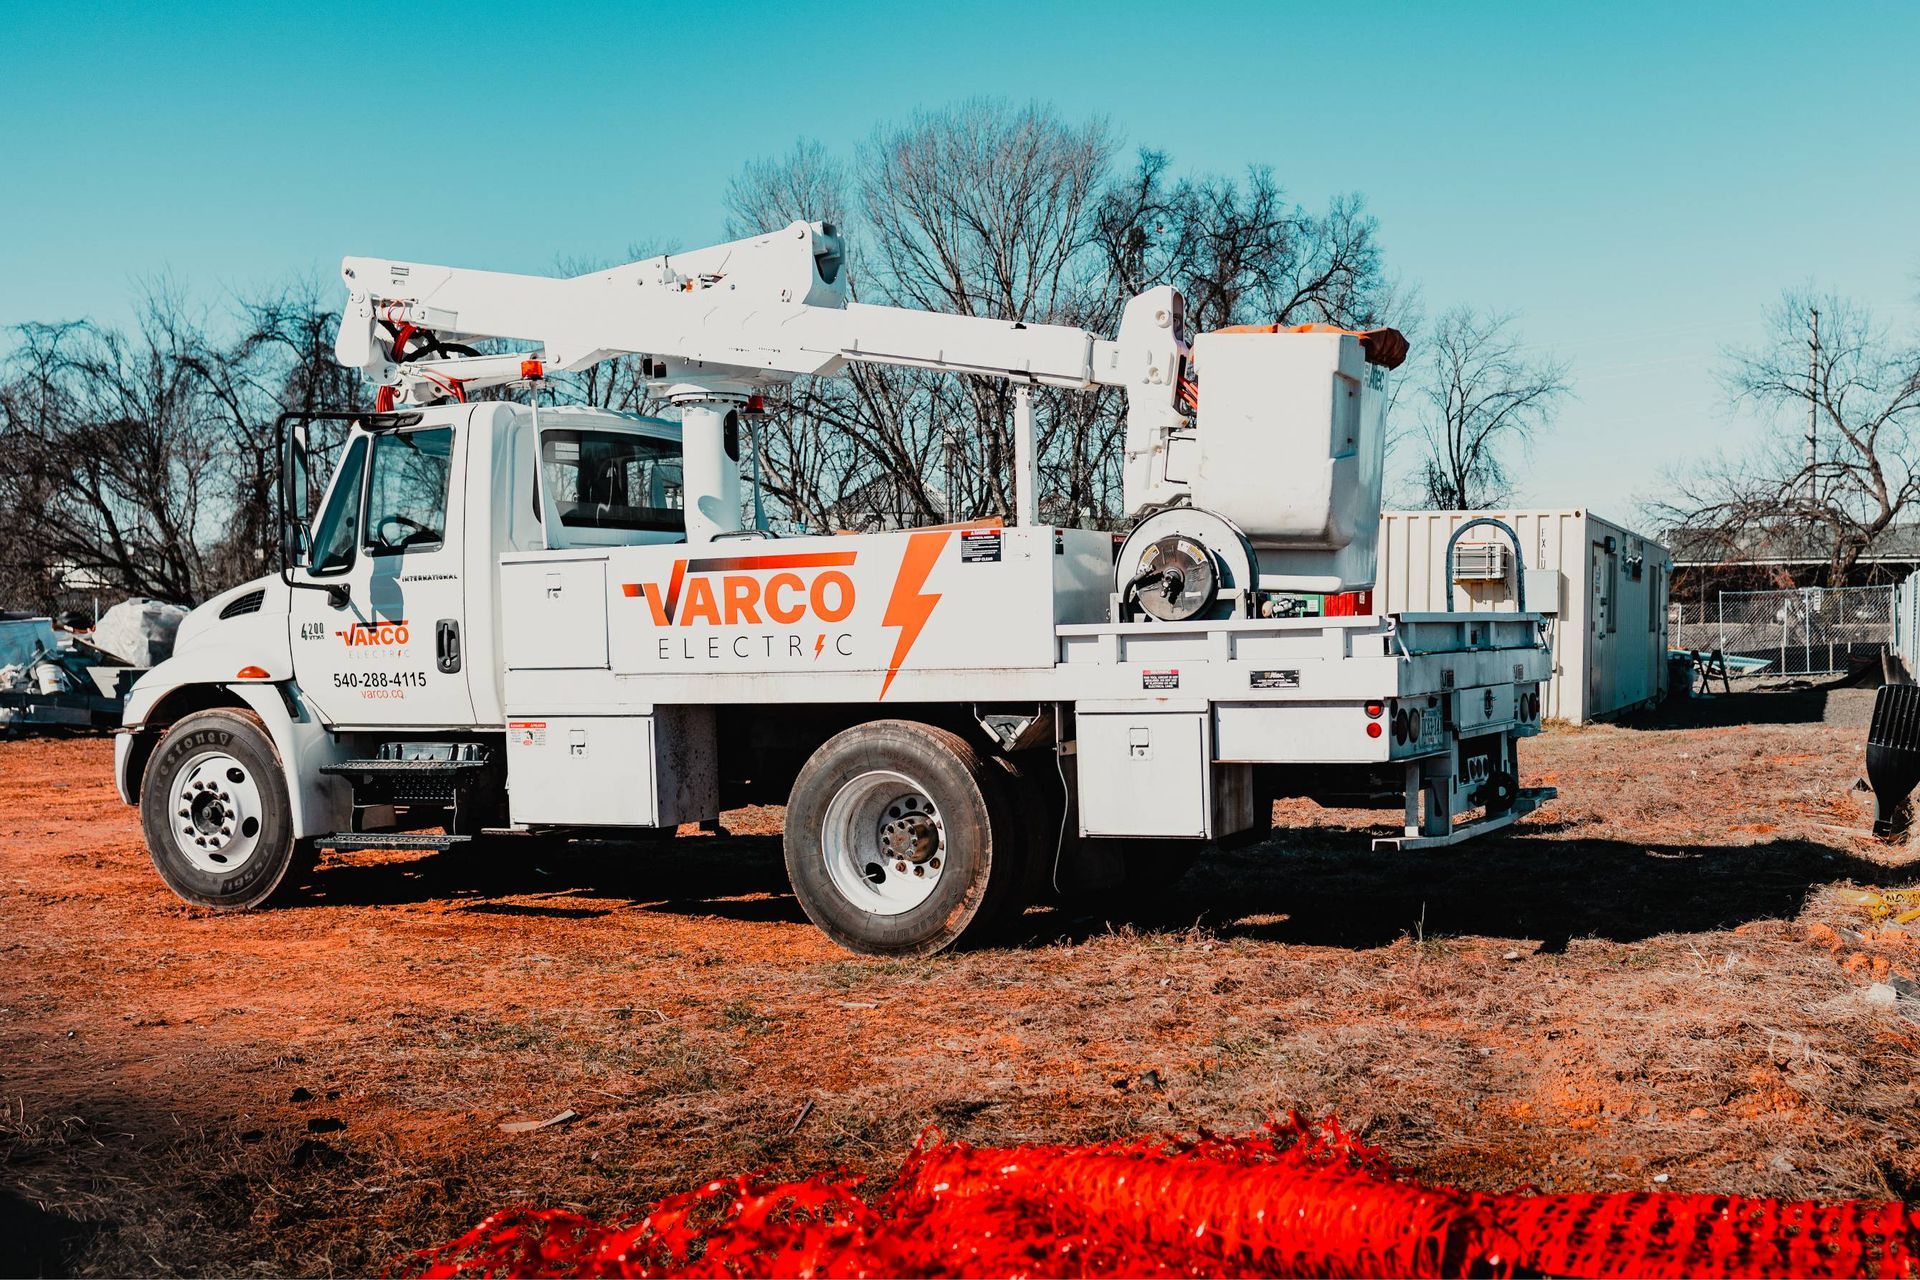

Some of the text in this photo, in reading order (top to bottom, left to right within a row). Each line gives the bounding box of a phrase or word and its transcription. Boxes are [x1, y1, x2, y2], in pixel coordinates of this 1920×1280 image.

[401, 574, 458, 583] INTERNATIONAL
[622, 552, 857, 627] VARCO
[301, 622, 324, 640] 4200
[335, 620, 409, 646] VARCO
[333, 672, 427, 688] 540-288-4115
